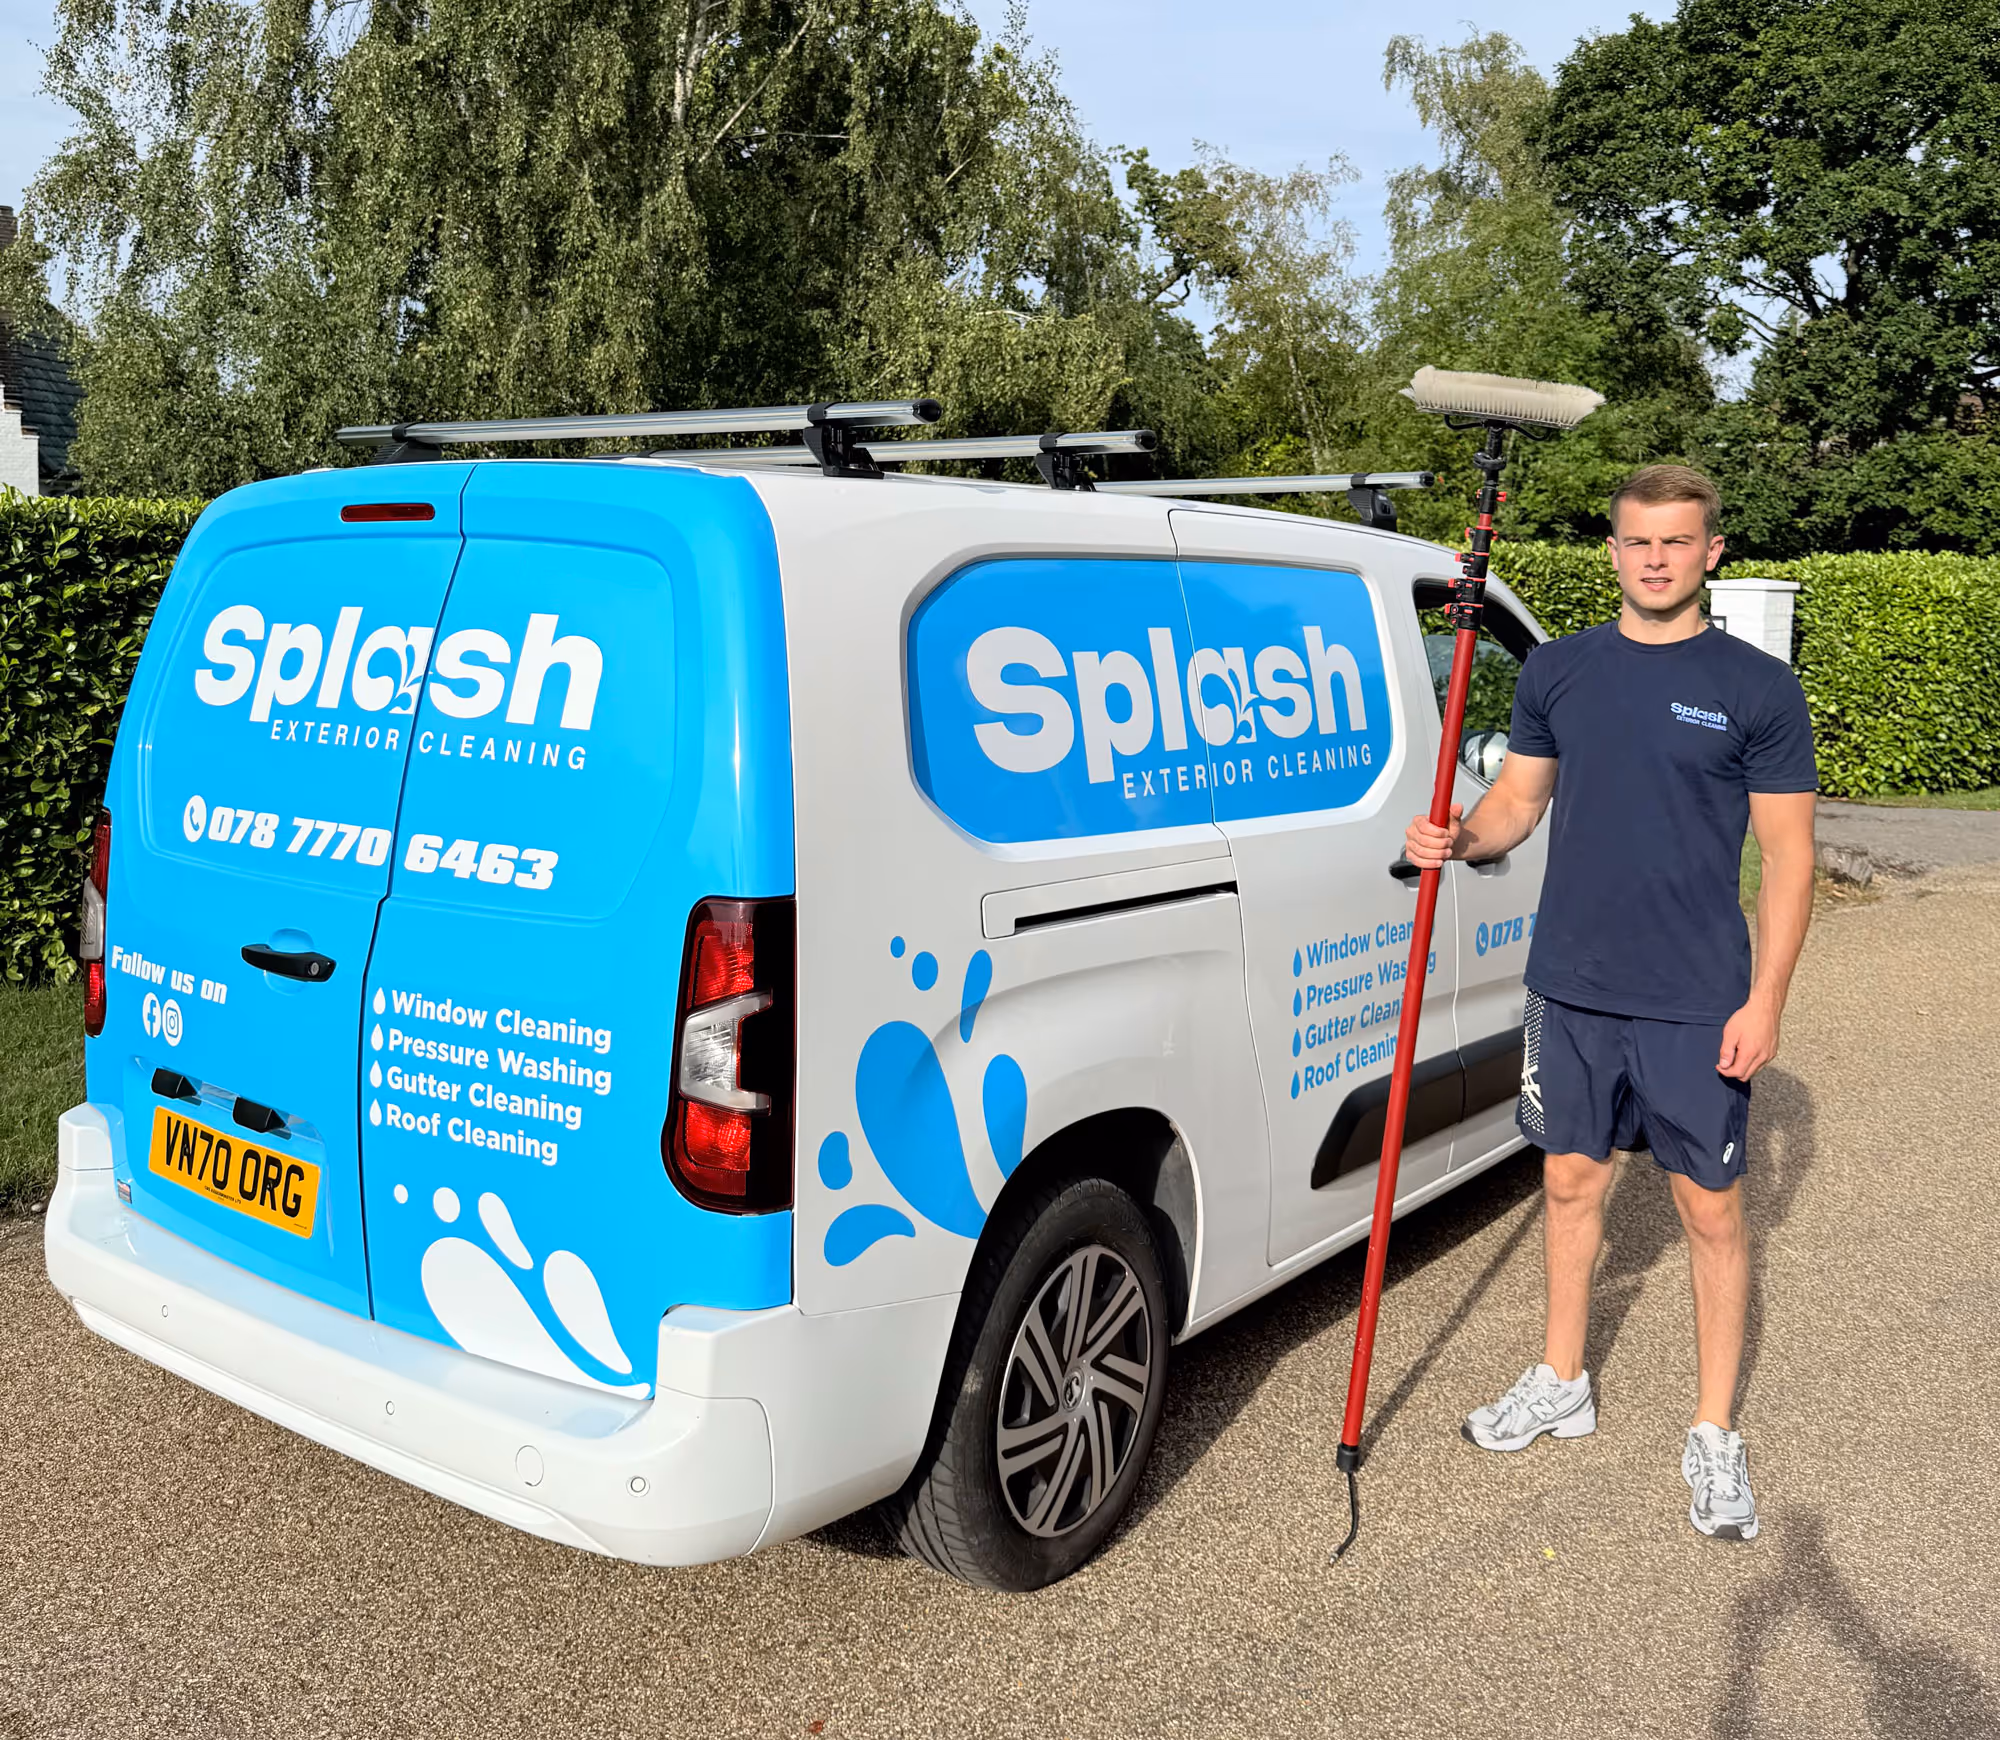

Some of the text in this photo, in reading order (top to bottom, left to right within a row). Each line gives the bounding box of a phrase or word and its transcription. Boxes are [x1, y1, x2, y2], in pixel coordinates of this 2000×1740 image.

[195, 605, 604, 731] Splash
[966, 626, 1368, 785] Splash
[1670, 702, 1727, 725] Splash
[271, 720, 586, 769] EXTERIOR CLEANING
[1123, 744, 1372, 799] EXTERIOR CLEANING
[207, 807, 559, 890] 078 7770 6463
[1306, 933, 1371, 969] Window
[1490, 916, 1524, 949] 078
[111, 945, 228, 1005] Follow us on
[1306, 951, 1436, 1011] Pressure Wasg
[392, 989, 612, 1055] Window Cleaning
[1305, 1016, 1356, 1050] Gutter
[388, 1027, 612, 1096] Pressure Washing
[1303, 1032, 1397, 1092] Roof Cleanin
[386, 1066, 582, 1131] Gutter Cleaning
[386, 1104, 558, 1167] Roof Cleaning
[166, 1115, 305, 1218] VN70 ORG
